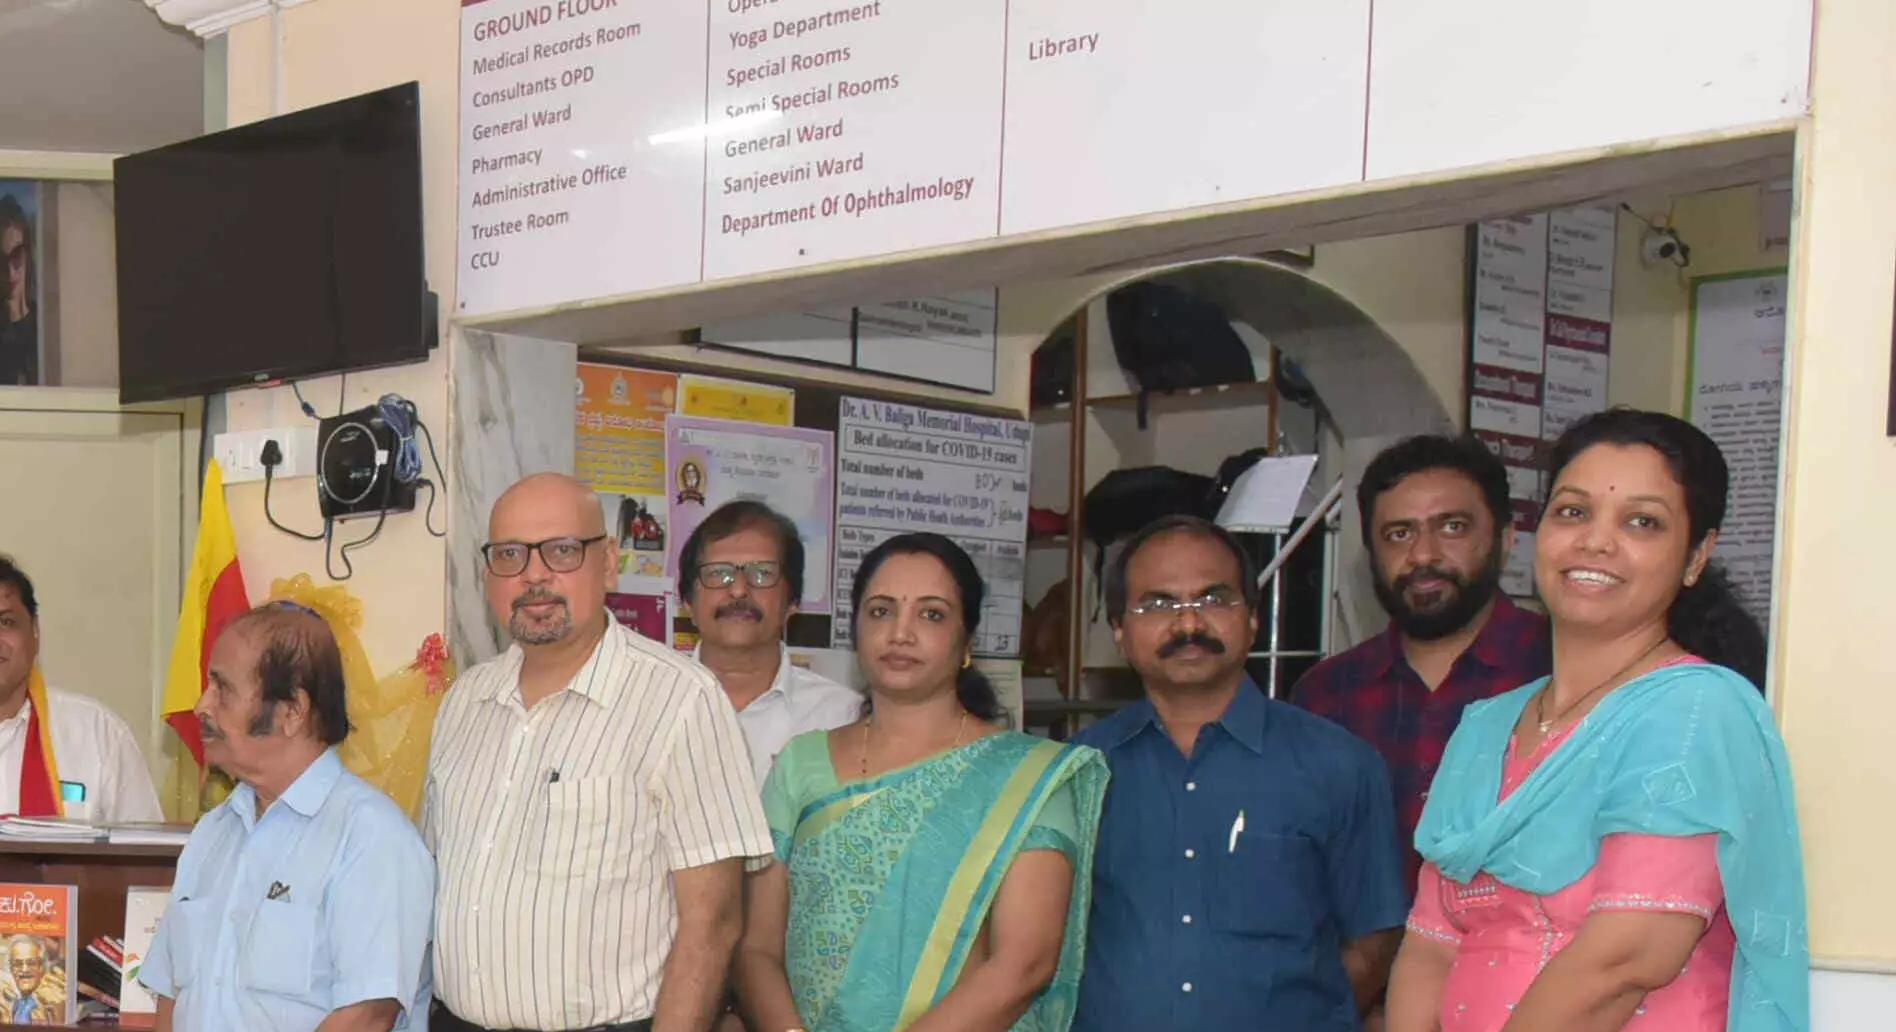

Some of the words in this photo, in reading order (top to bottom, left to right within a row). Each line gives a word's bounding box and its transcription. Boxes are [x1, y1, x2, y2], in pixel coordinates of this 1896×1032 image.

[474, 6, 552, 41] GROUND
[729, 28, 767, 49] Yoga
[773, 1, 880, 38] Department
[473, 46, 529, 75] Medical
[534, 32, 592, 61] Records
[596, 23, 641, 44] Room
[1029, 33, 1098, 60] Library
[727, 56, 785, 87] Special
[791, 47, 851, 72] Rooms
[473, 76, 556, 108] Consultants
[561, 66, 594, 87] OPD
[771, 83, 832, 112] Special
[838, 73, 900, 98] Rooms
[472, 115, 528, 141] General
[532, 103, 572, 127] Ward
[725, 128, 791, 157] General
[797, 119, 843, 144] Ward
[472, 148, 543, 174] Pharmacy
[723, 163, 810, 194] Sanjeevini
[816, 152, 864, 178] Ward
[472, 174, 577, 207] Administrative
[582, 164, 627, 186] Office
[472, 217, 522, 240] Trustee
[527, 210, 569, 230] Room
[722, 205, 815, 236] Department
[821, 197, 840, 217] Of
[844, 177, 974, 217] Ophthalmology
[471, 251, 499, 270] CCU
[842, 399, 857, 419] Dr.
[885, 406, 914, 432] Baliga
[918, 410, 962, 433] Memorial
[964, 415, 1004, 440] Hospital,
[854, 430, 873, 446] Bed
[876, 434, 922, 452] allocation
[925, 439, 940, 456] for
[942, 440, 992, 463] COVID-19
[994, 451, 1017, 465] cases
[841, 458, 861, 473] Total
[863, 461, 895, 478] number
[896, 465, 905, 479] of
